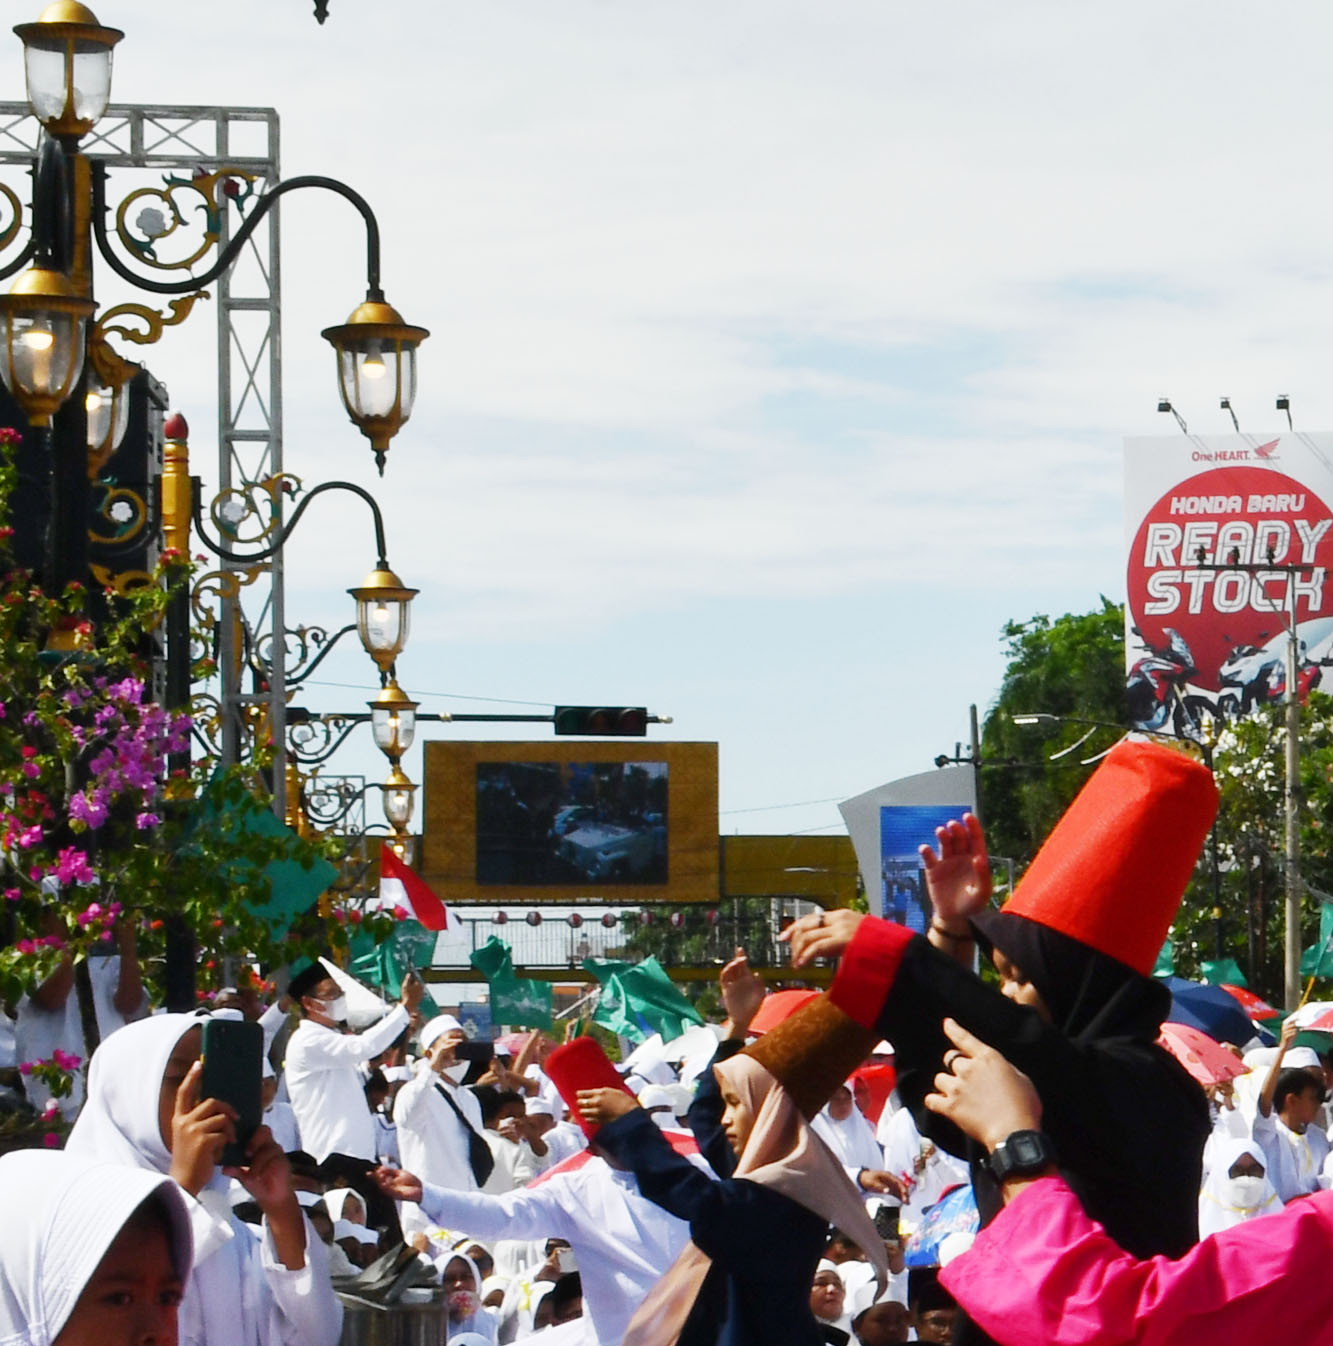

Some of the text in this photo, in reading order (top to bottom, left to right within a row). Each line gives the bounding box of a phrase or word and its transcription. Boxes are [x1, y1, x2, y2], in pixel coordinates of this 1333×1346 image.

[1191, 450, 1213, 461] One
[1170, 494, 1305, 515] HONDA BARU
[1144, 519, 1333, 567] READY
[1144, 567, 1326, 615] STOCK
